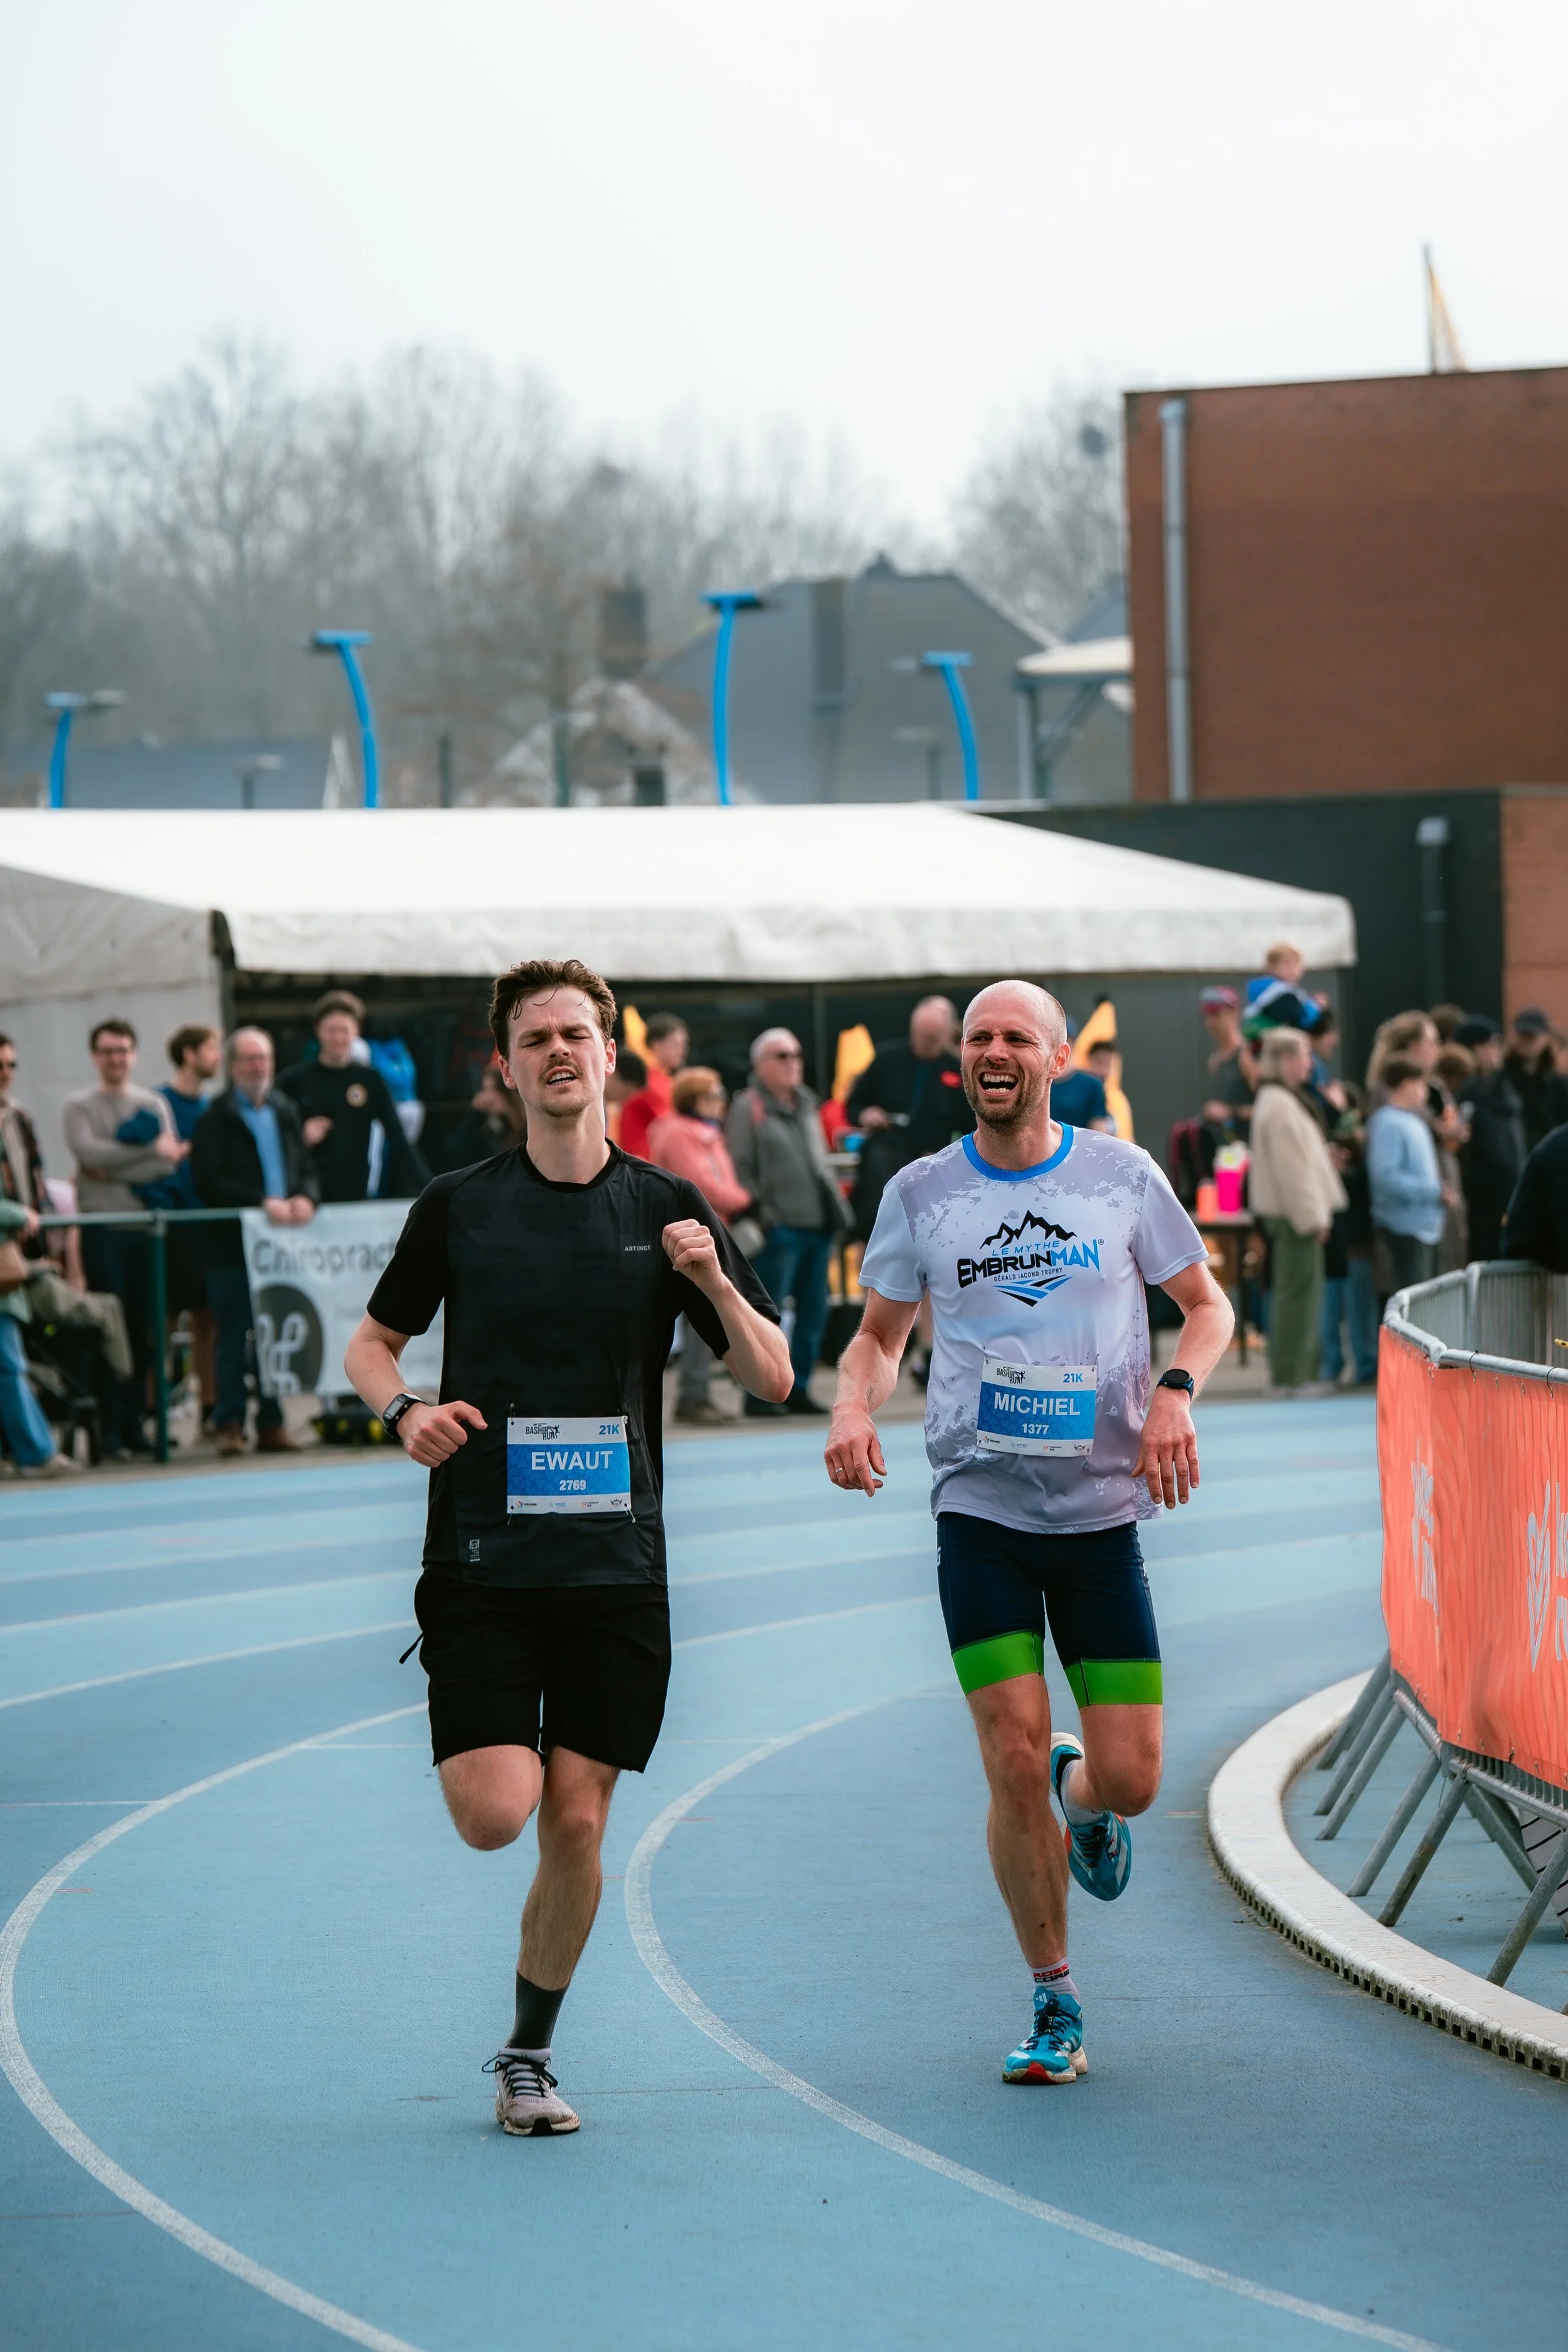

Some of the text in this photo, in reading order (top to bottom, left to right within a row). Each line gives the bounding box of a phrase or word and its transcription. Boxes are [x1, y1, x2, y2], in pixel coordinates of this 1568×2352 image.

[992, 1241, 1060, 1256] LE MYTHE
[957, 1239, 1099, 1288] EMBRUNMAN
[993, 1267, 1063, 1283] GÉRALD IACONO TROPHY
[1063, 1373, 1083, 1383] 21K
[994, 1392, 1080, 1416] MICHIEL
[598, 1424, 620, 1434] 21K
[1022, 1423, 1049, 1434] 1377
[532, 1451, 613, 1471] EWAUT
[559, 1480, 586, 1491] 2769
